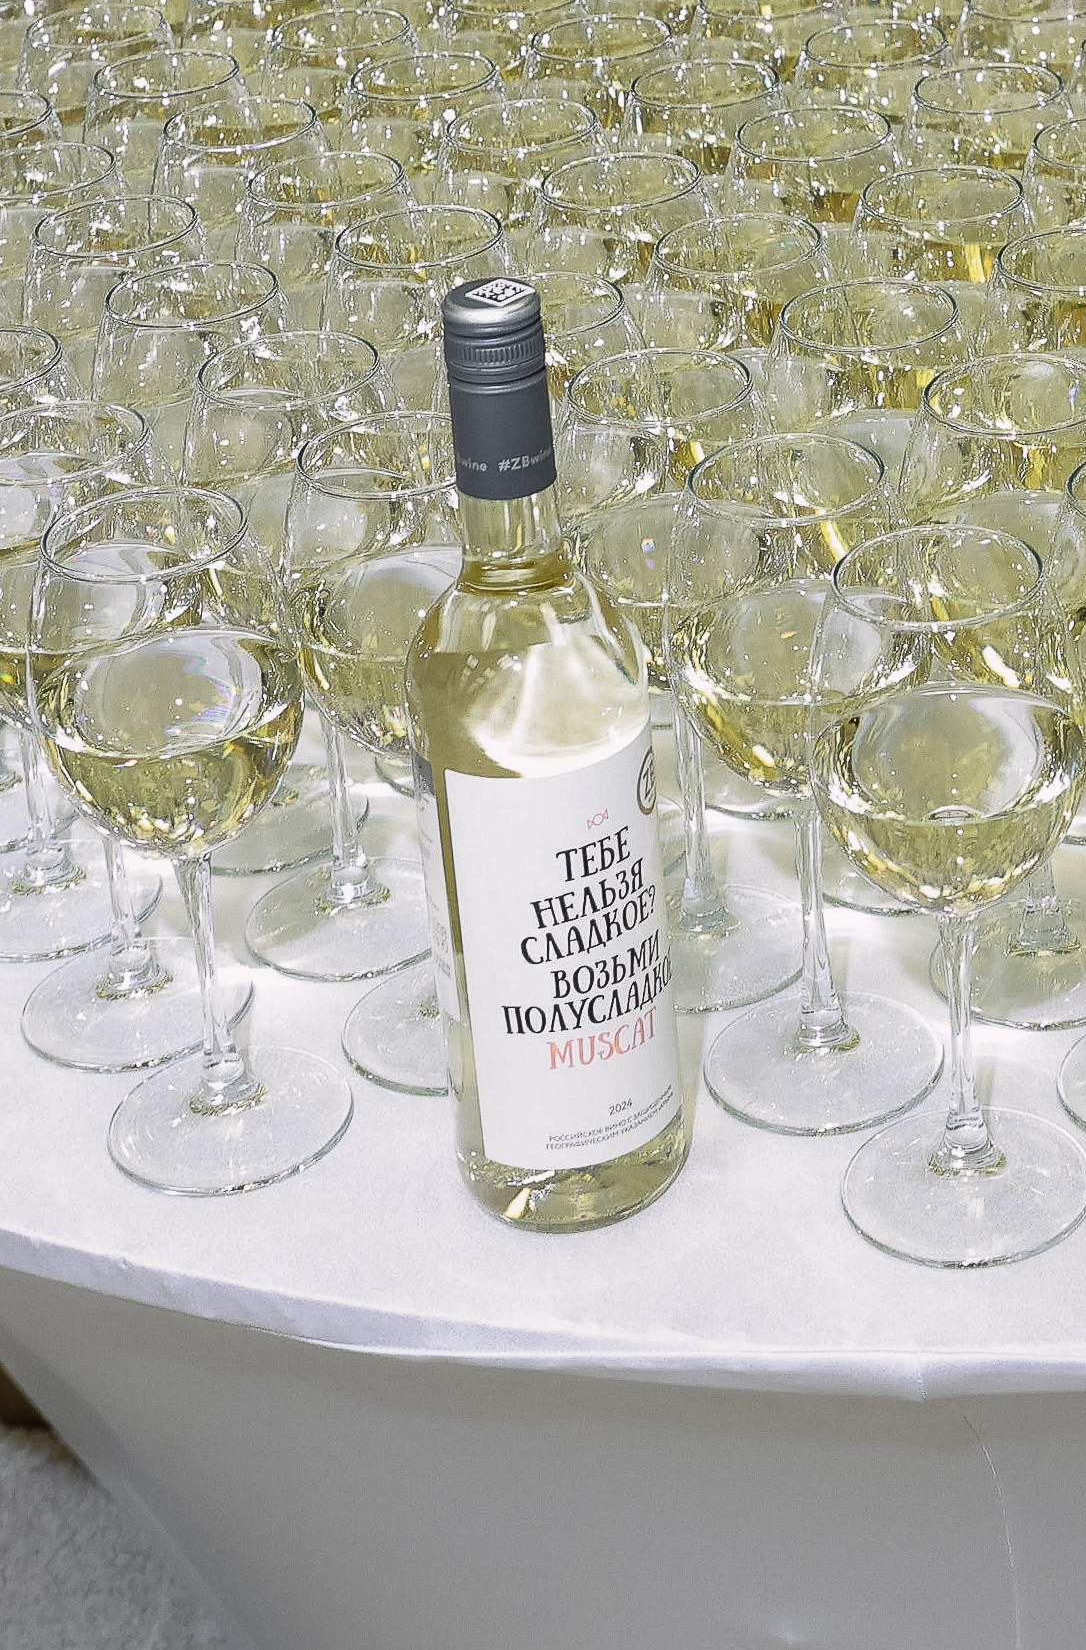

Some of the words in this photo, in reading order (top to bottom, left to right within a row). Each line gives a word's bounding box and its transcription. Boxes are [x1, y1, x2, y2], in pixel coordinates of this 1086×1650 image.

[556, 825, 631, 882] ТЕБЕ
[520, 884, 656, 965] СЛАДКОЕ?
[530, 858, 644, 929] НЕЛЬЗЯ
[551, 928, 659, 999] ВОЗЬМИ
[546, 1006, 657, 1070] MUSCAT
[609, 1098, 633, 1116] 2024
